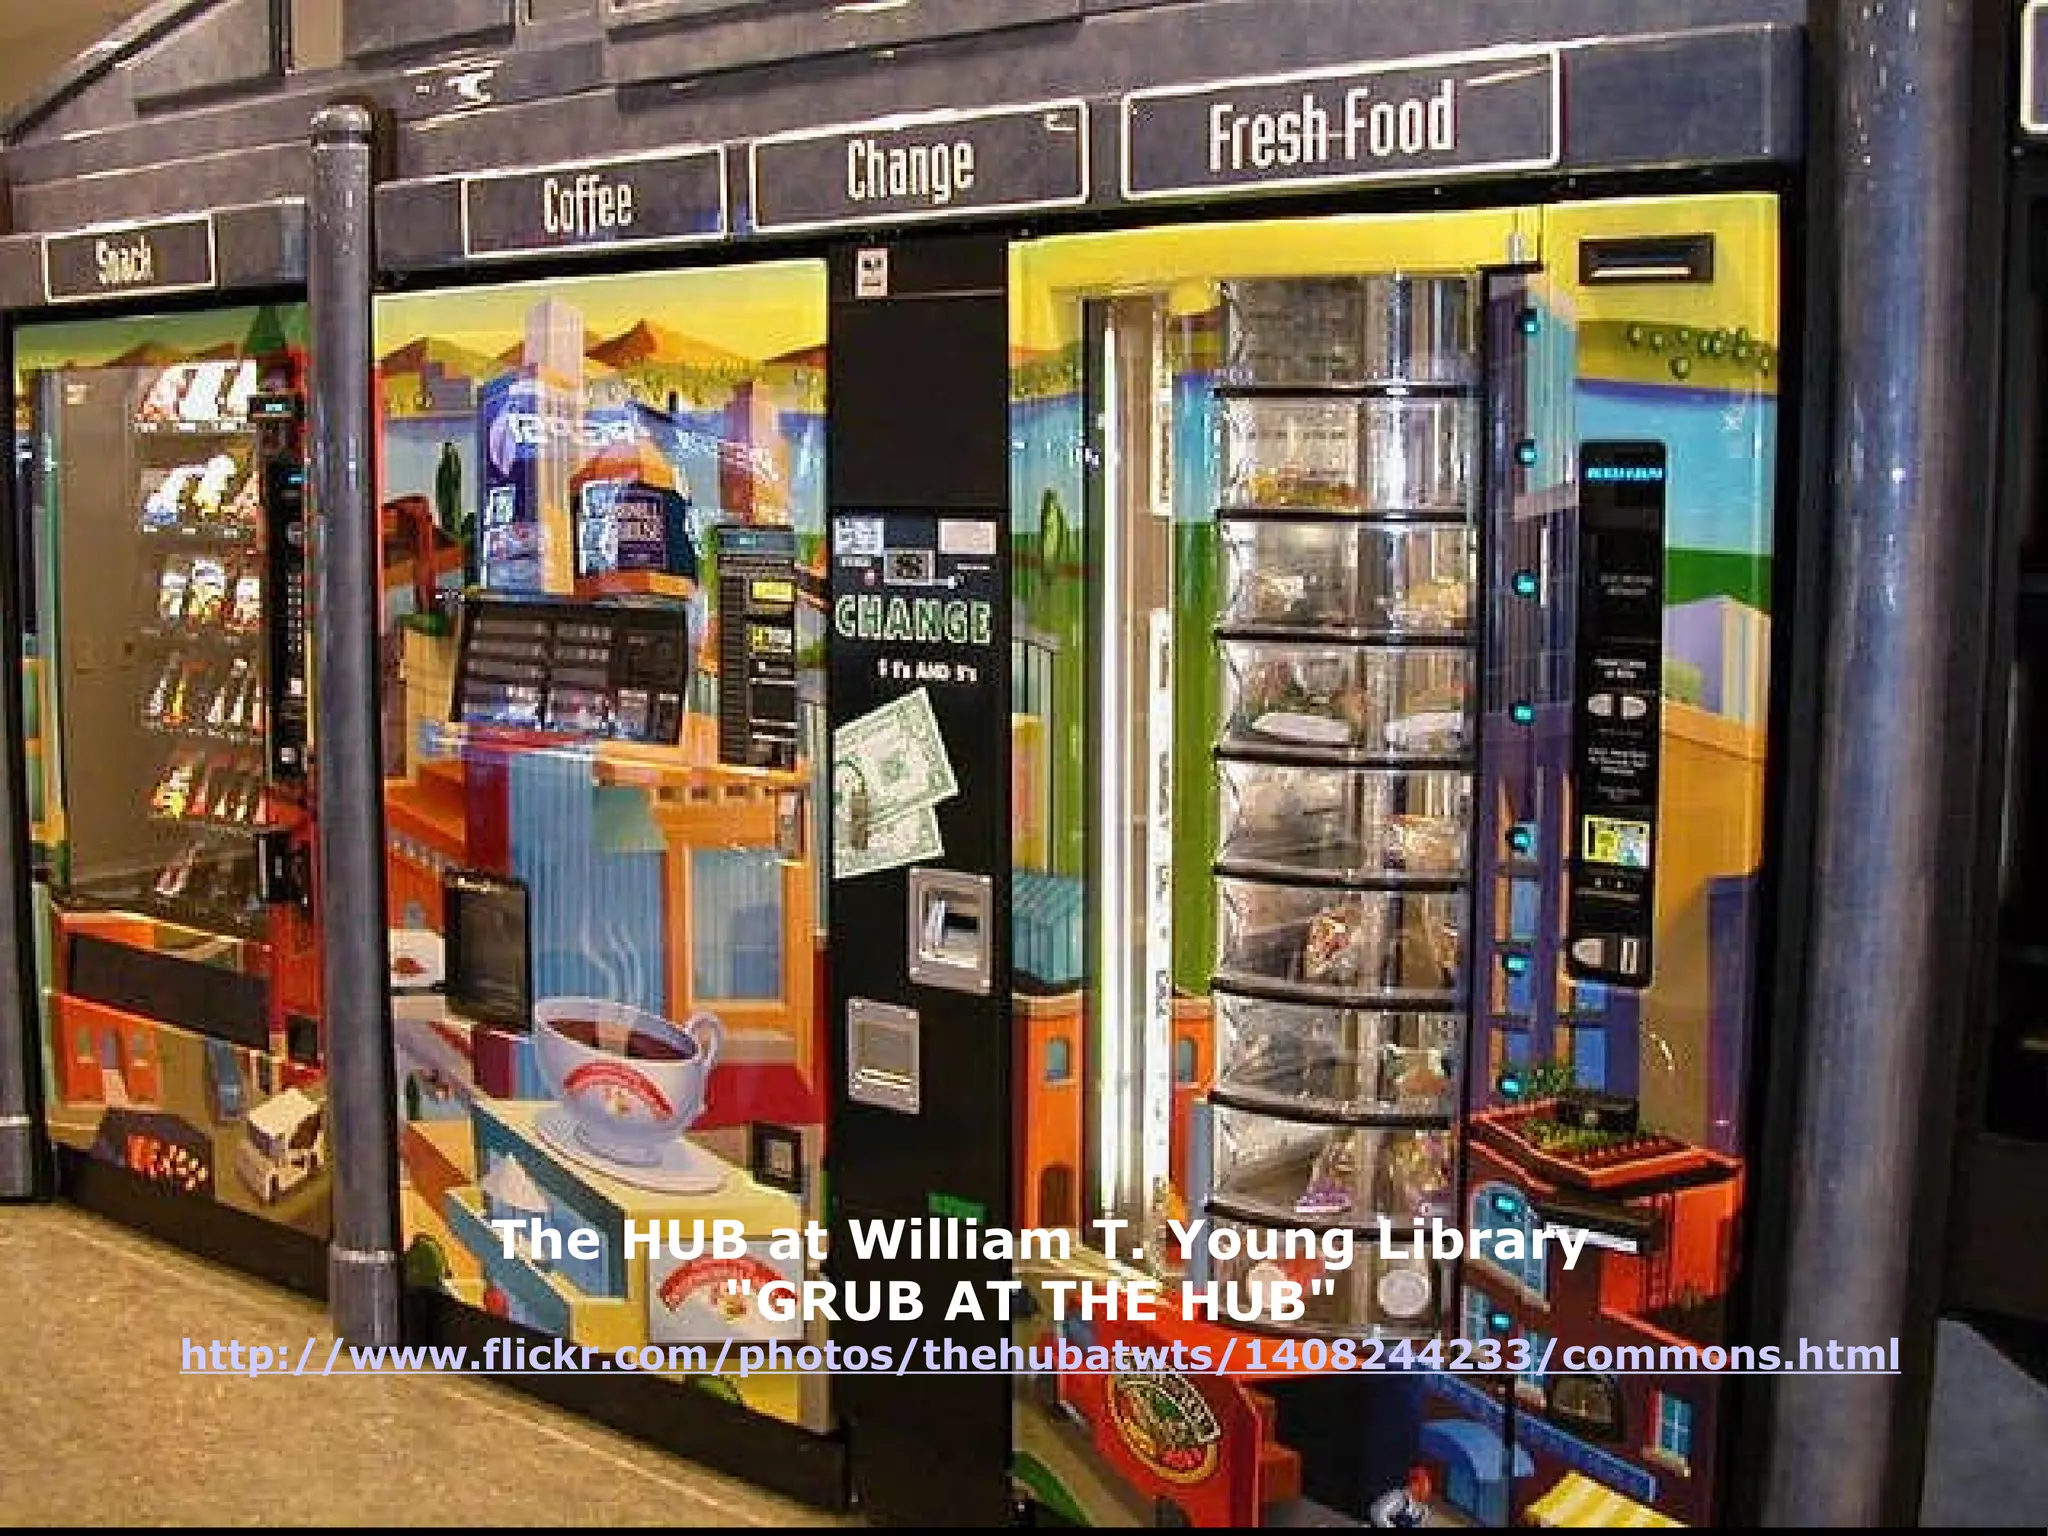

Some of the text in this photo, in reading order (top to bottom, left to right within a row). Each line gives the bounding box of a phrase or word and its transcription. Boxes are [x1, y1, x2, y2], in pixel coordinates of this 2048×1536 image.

[1208, 78, 1456, 172] Fresh Food
[846, 138, 976, 206] Change
[543, 174, 634, 236] Coffee
[834, 594, 993, 645] CHANGE
